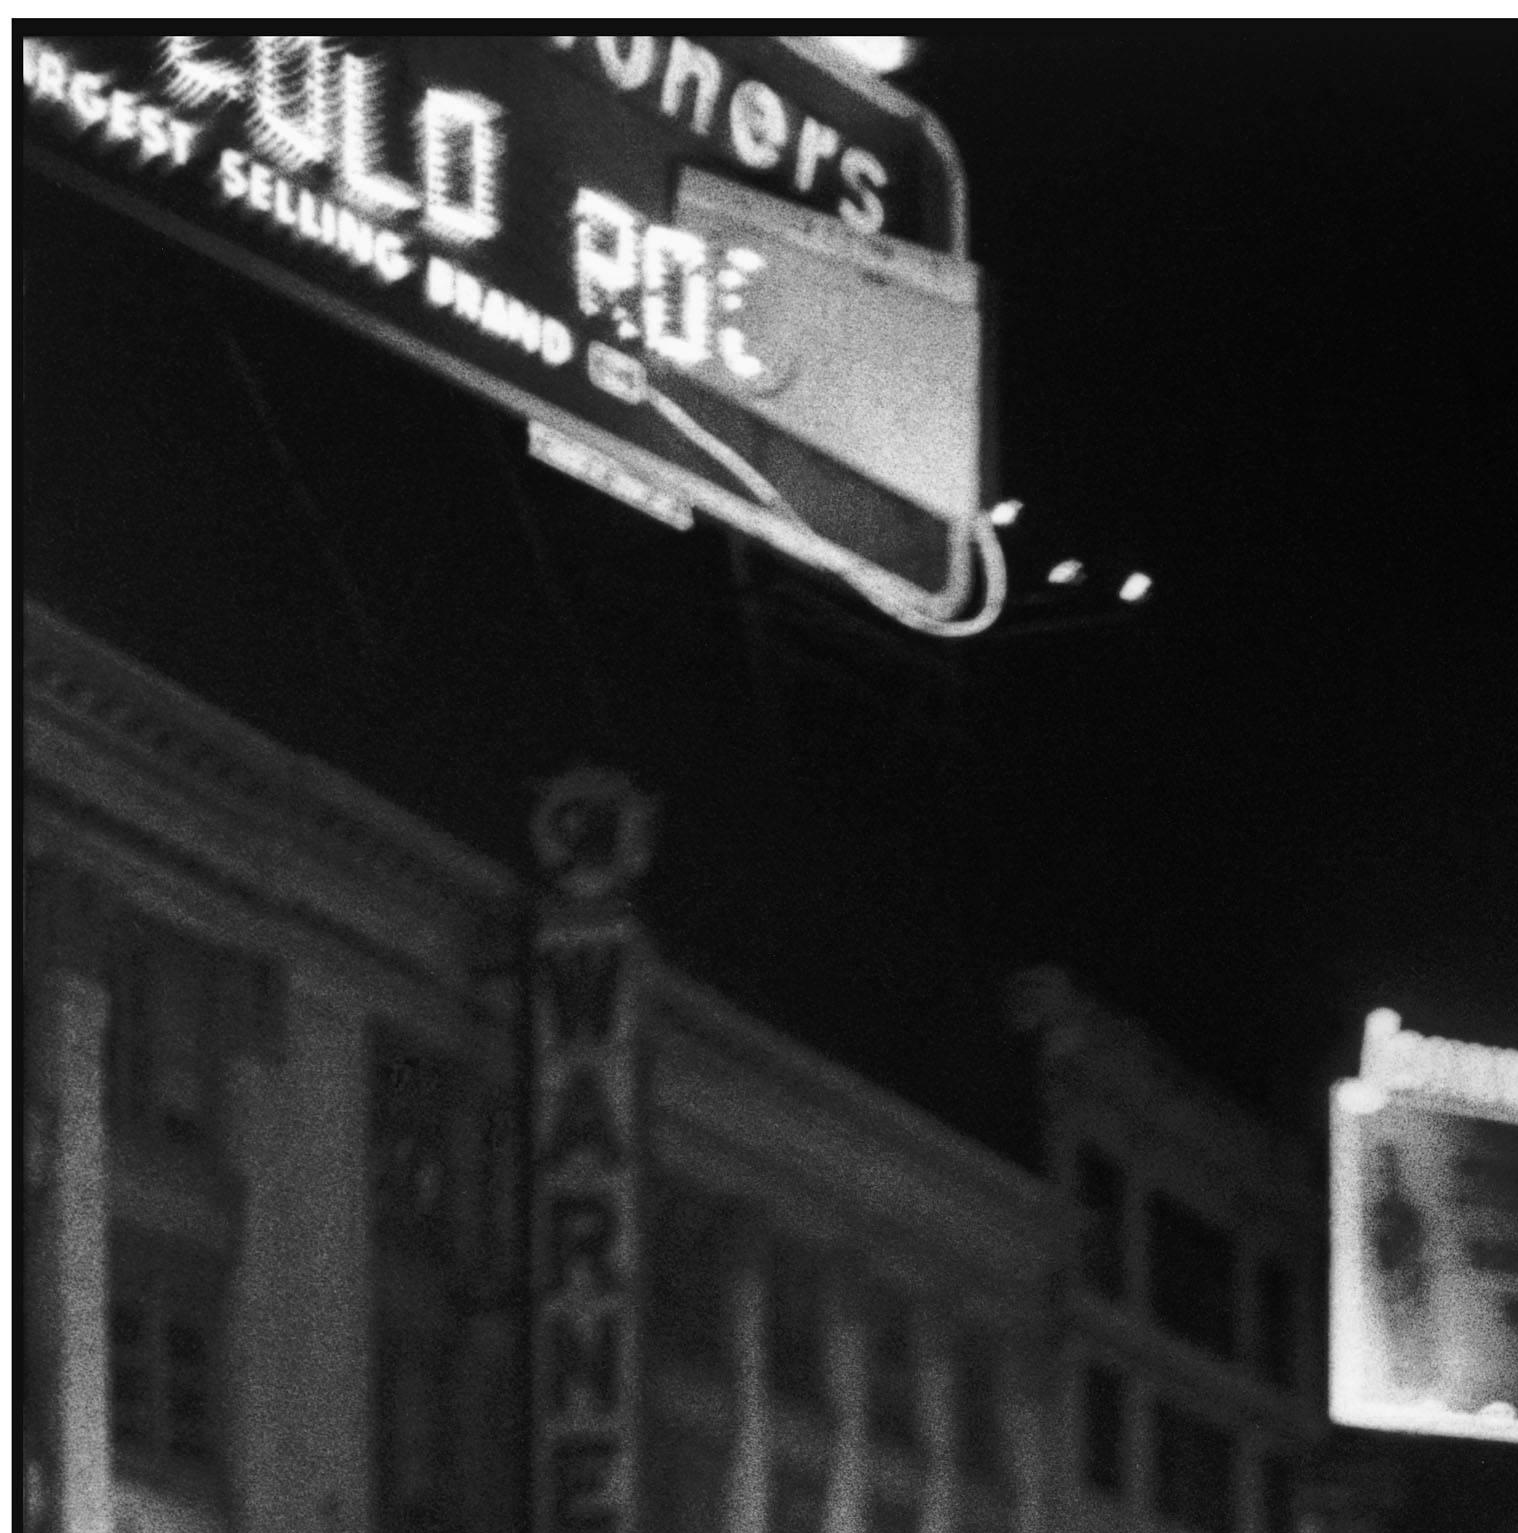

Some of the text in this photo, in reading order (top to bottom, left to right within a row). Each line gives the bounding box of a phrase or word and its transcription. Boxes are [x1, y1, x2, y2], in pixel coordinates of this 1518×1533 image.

[553, 36, 889, 235] oners
[219, 148, 413, 282] SELLING
[427, 256, 572, 366] BRAND
